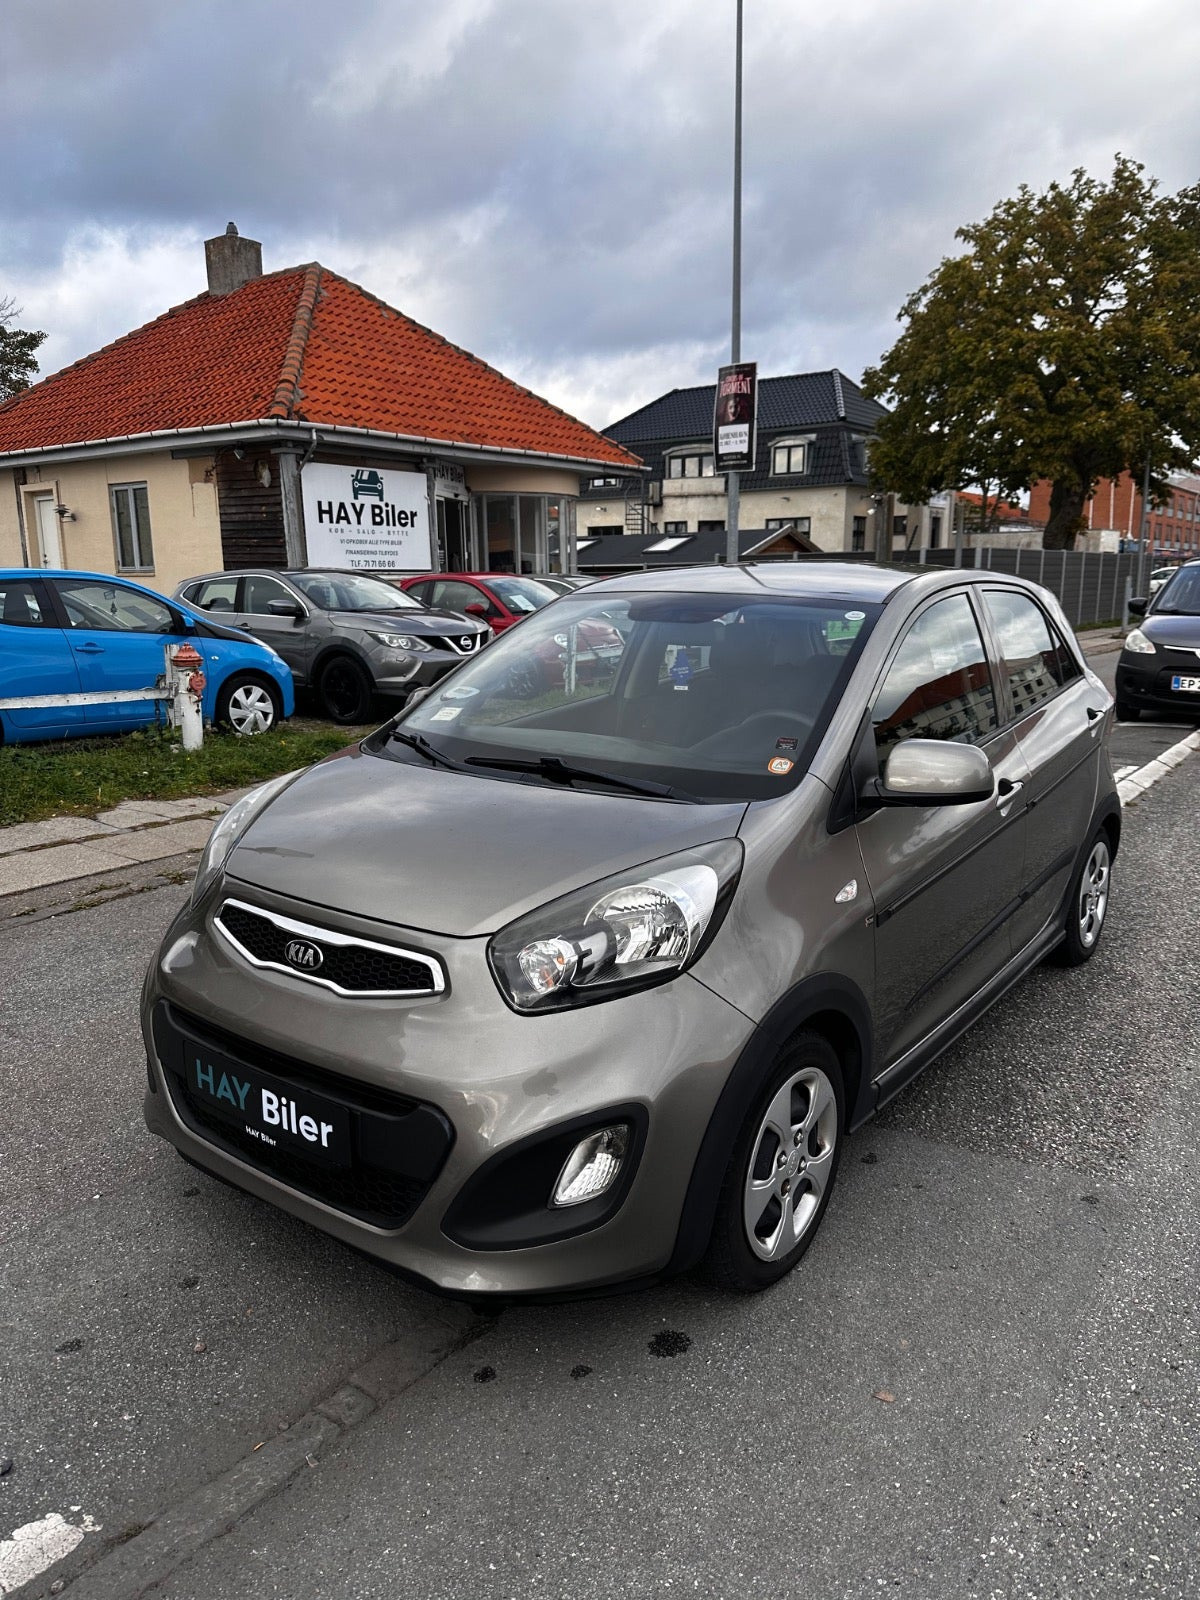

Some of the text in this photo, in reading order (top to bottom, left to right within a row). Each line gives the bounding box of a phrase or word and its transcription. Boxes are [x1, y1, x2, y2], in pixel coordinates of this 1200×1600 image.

[317, 500, 418, 528] HAY Biler
[350, 560, 363, 568] TLF.
[364, 560, 370, 568] 71
[371, 560, 377, 568] 71
[1181, 679, 1195, 689] EP
[289, 943, 314, 966] KIA
[196, 1059, 333, 1147] HAY Biler
[245, 1125, 277, 1146] HAY Biler
